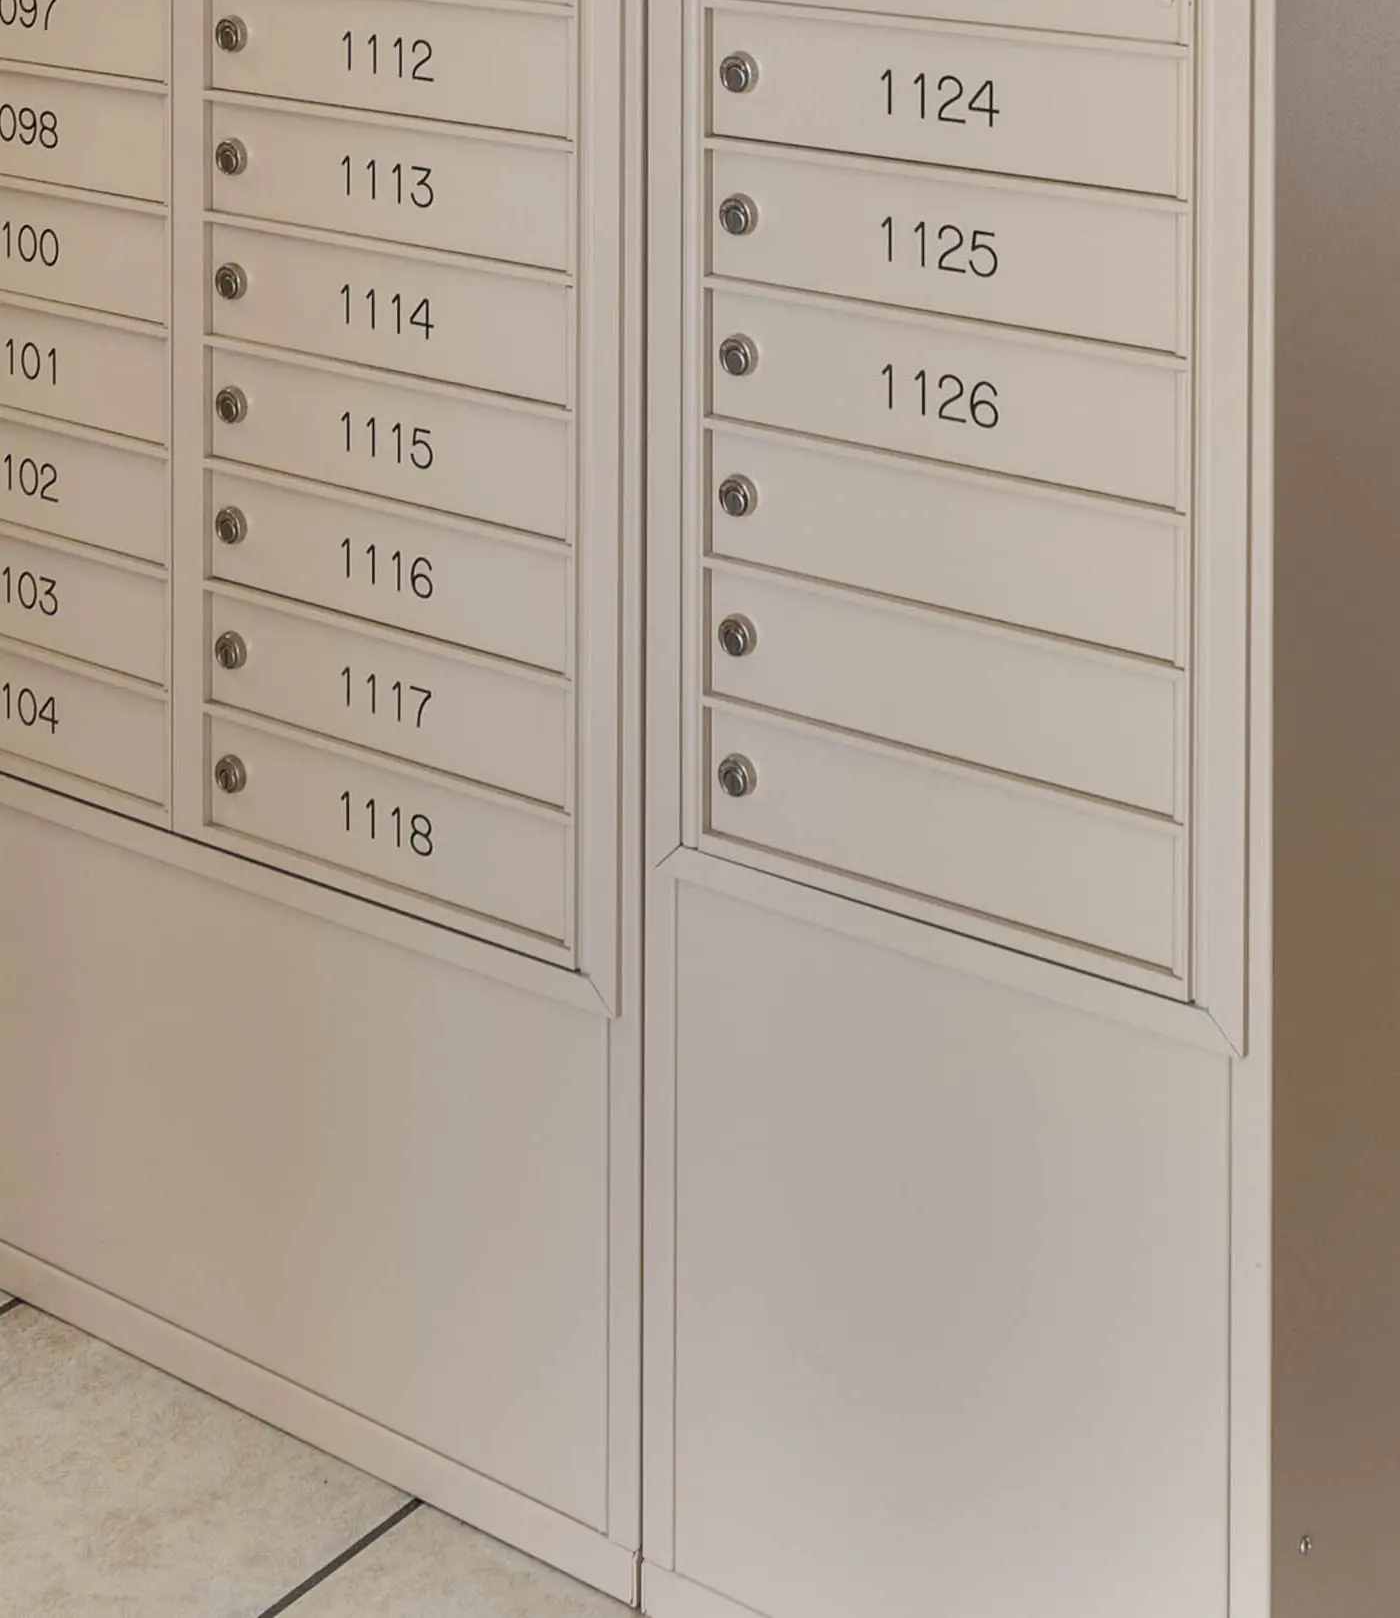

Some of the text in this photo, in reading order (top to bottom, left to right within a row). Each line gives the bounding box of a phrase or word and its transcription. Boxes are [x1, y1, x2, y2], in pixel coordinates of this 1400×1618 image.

[341, 30, 435, 83] 1112
[880, 68, 1001, 128] 1124
[340, 154, 434, 209] 1113
[2, 221, 60, 267] 100
[880, 215, 999, 279] 1125
[340, 283, 435, 341] 1114
[5, 338, 57, 386] 101
[881, 363, 999, 429] 1126
[340, 411, 434, 470] 1115
[3, 453, 59, 503] 102
[2, 565, 59, 617] 103
[340, 537, 434, 600] 1116
[2, 682, 59, 735] 104
[340, 666, 432, 729] 1117
[340, 792, 434, 857] 1118
